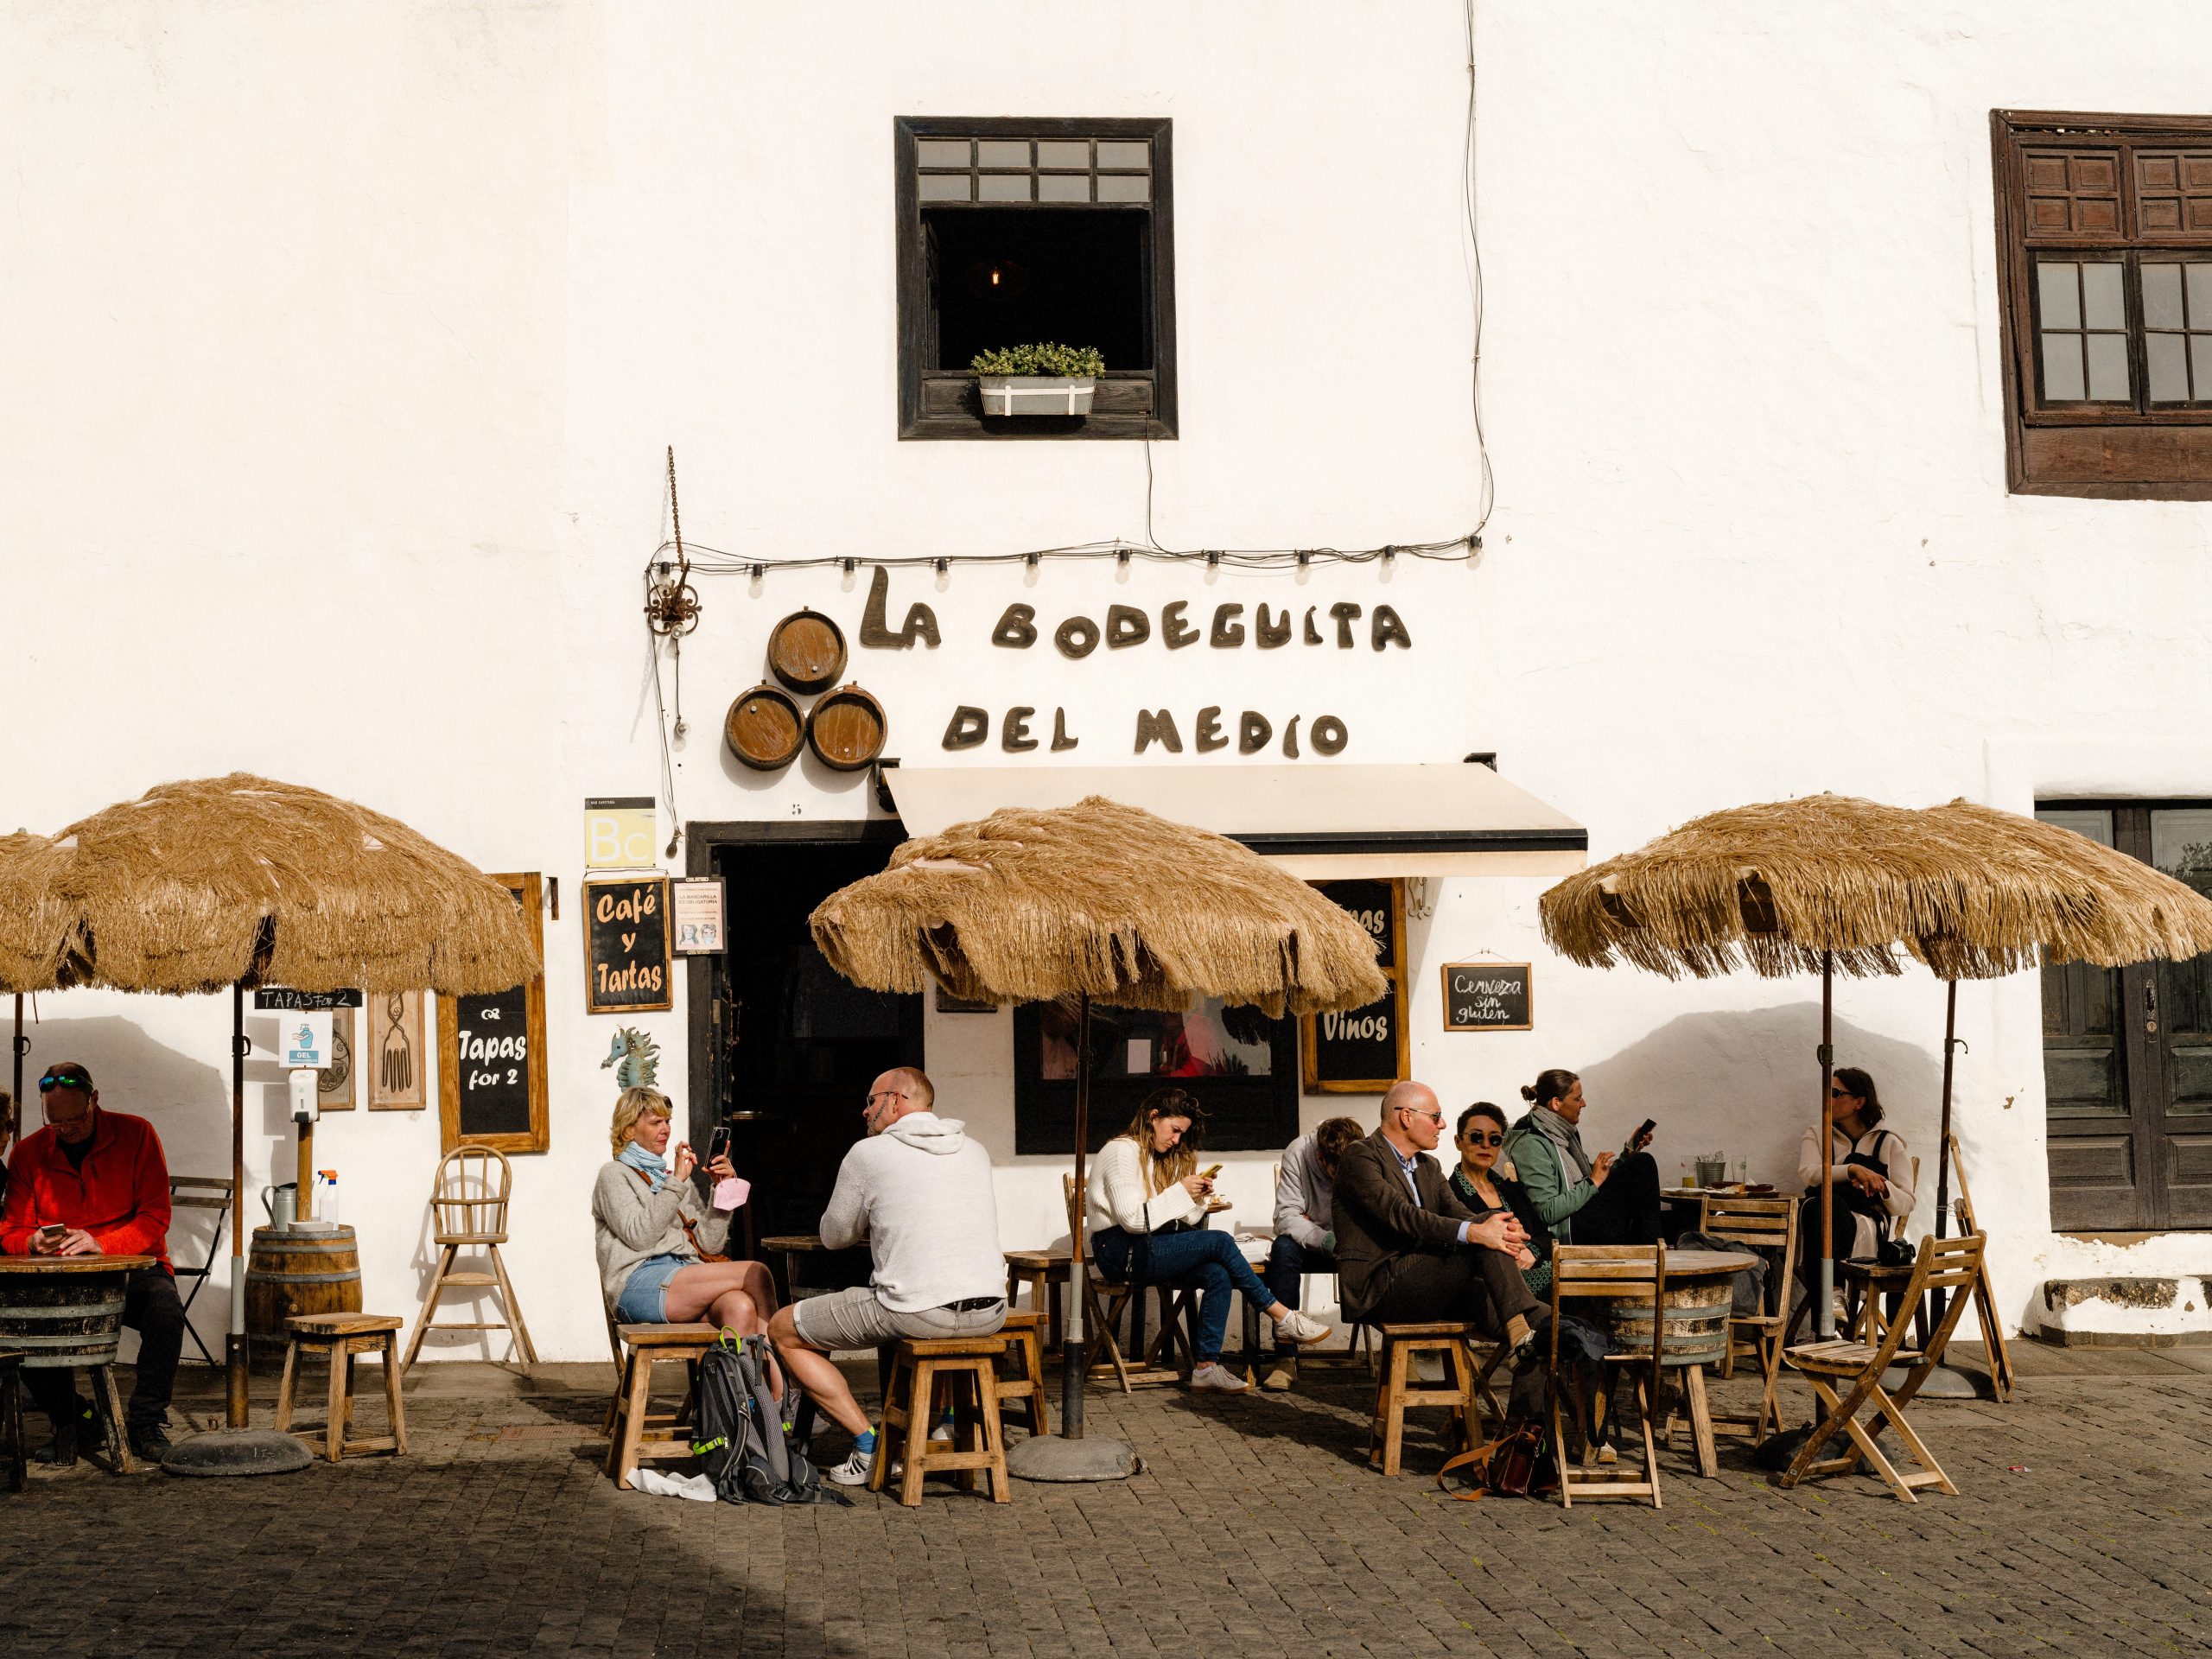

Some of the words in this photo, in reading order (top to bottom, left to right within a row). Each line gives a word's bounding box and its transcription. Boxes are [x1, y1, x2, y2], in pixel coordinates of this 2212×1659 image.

[859, 564, 942, 649] LA
[992, 600, 1412, 659] BODEGUITA
[942, 704, 1079, 753] DEL
[1134, 704, 1349, 759] MEDIO
[596, 883, 656, 924] Café
[621, 931, 637, 953] y
[597, 959, 662, 994] Tartas
[1454, 975, 1522, 995] Cerveza
[261, 991, 312, 1009] TAPAS
[336, 991, 352, 1007] 2
[1474, 995, 1501, 1008] sin
[1323, 1009, 1388, 1042] Vinos
[1456, 1005, 1510, 1024] gluten
[458, 1030, 526, 1067] Tapas
[468, 1070, 500, 1090] for
[506, 1068, 518, 1084] 2
